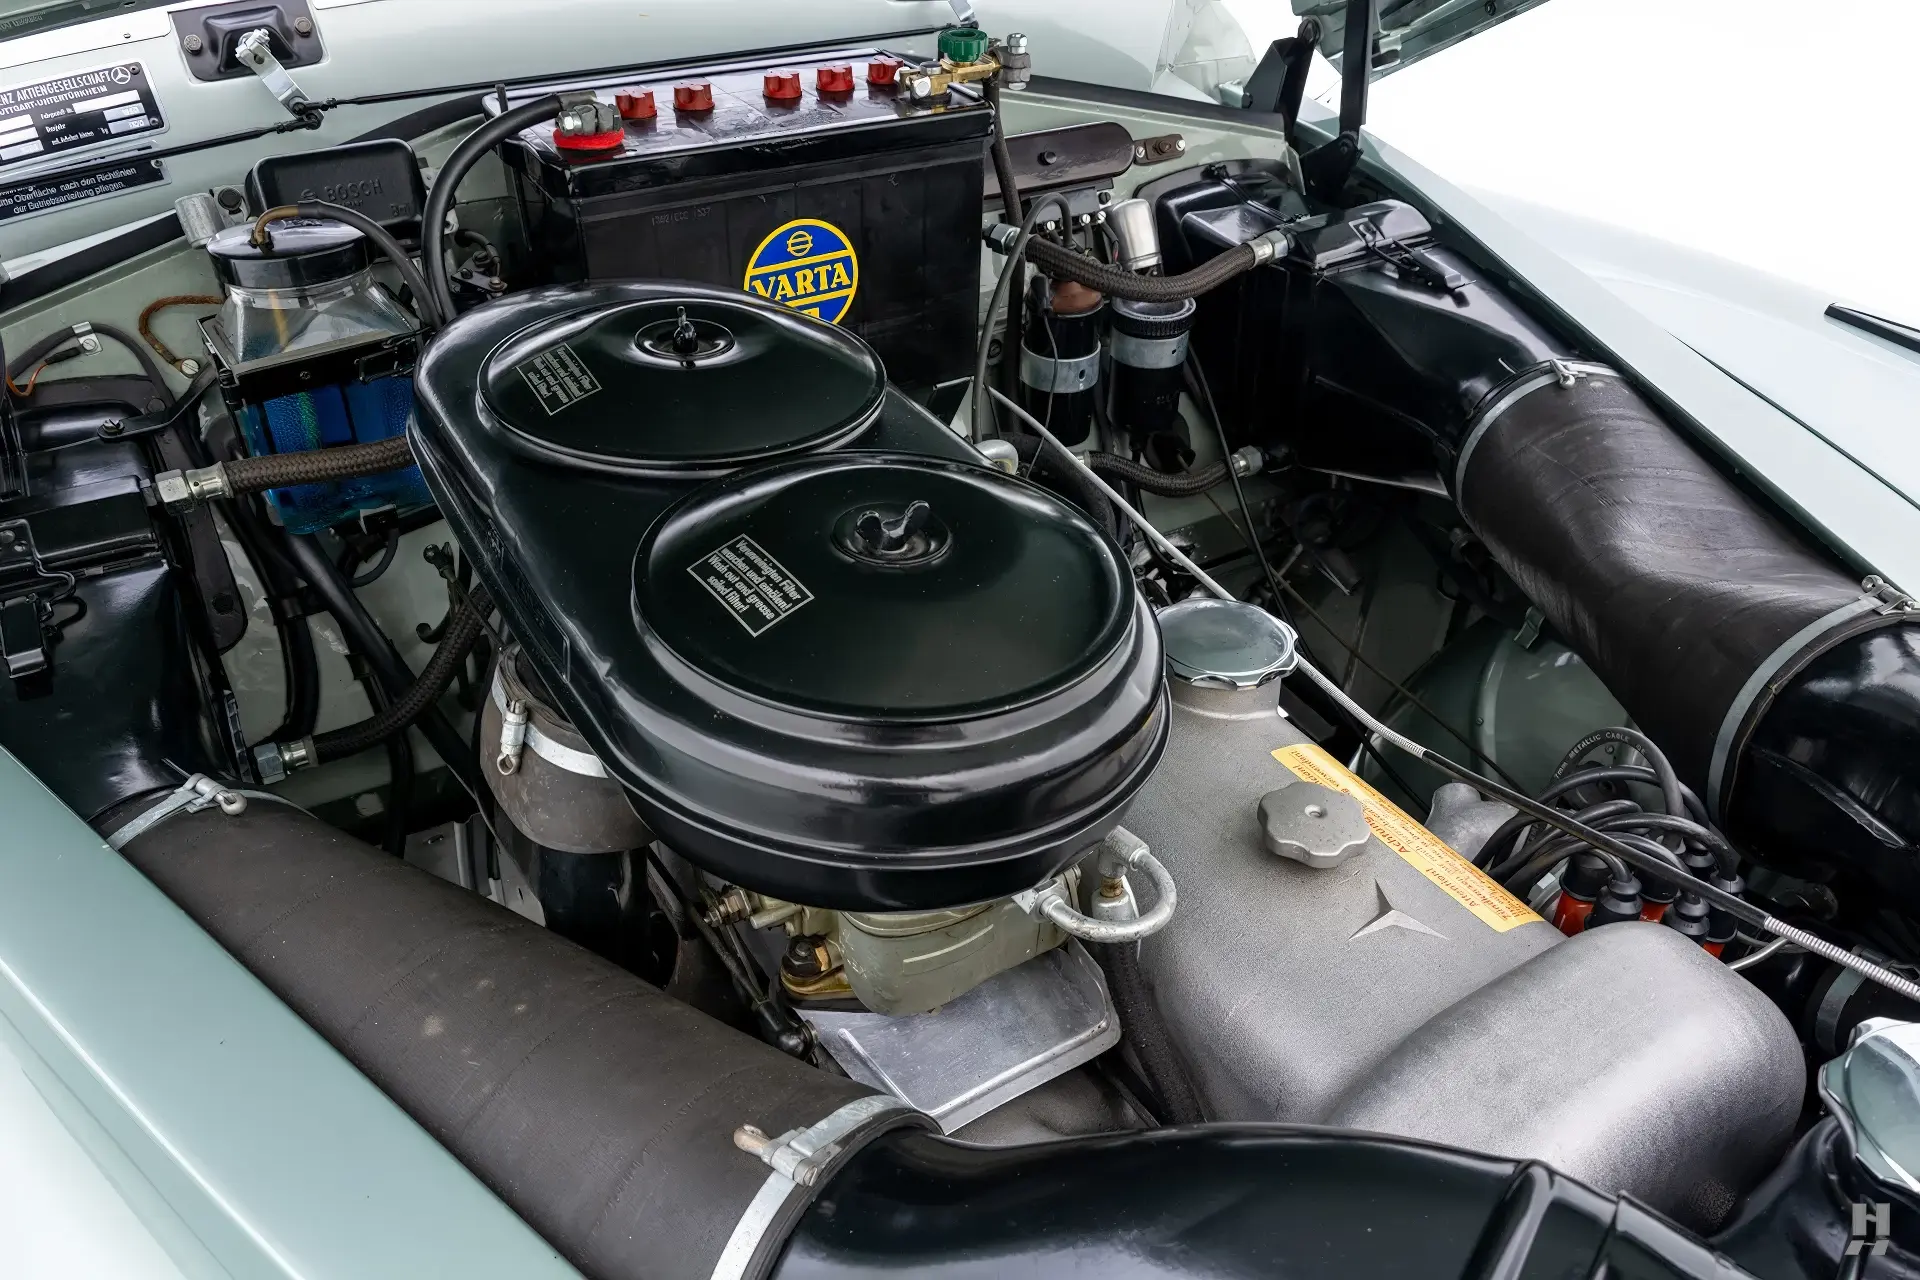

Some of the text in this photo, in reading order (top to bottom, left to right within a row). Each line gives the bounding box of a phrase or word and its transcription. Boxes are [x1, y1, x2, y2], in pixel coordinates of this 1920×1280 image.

[17, 70, 111, 102] AKTIENGESELLSCHAFT
[60, 179, 80, 191] nach
[80, 176, 96, 186] den
[97, 167, 137, 181] Richtlinien
[324, 179, 383, 201] BOSCH
[751, 262, 851, 301] VARTA
[708, 554, 775, 620] Wash out and grease
[746, 569, 766, 584] und
[1568, 734, 1601, 759] METALLIC
[1605, 731, 1630, 743] CABLE
[1425, 867, 1480, 907] Attention!
